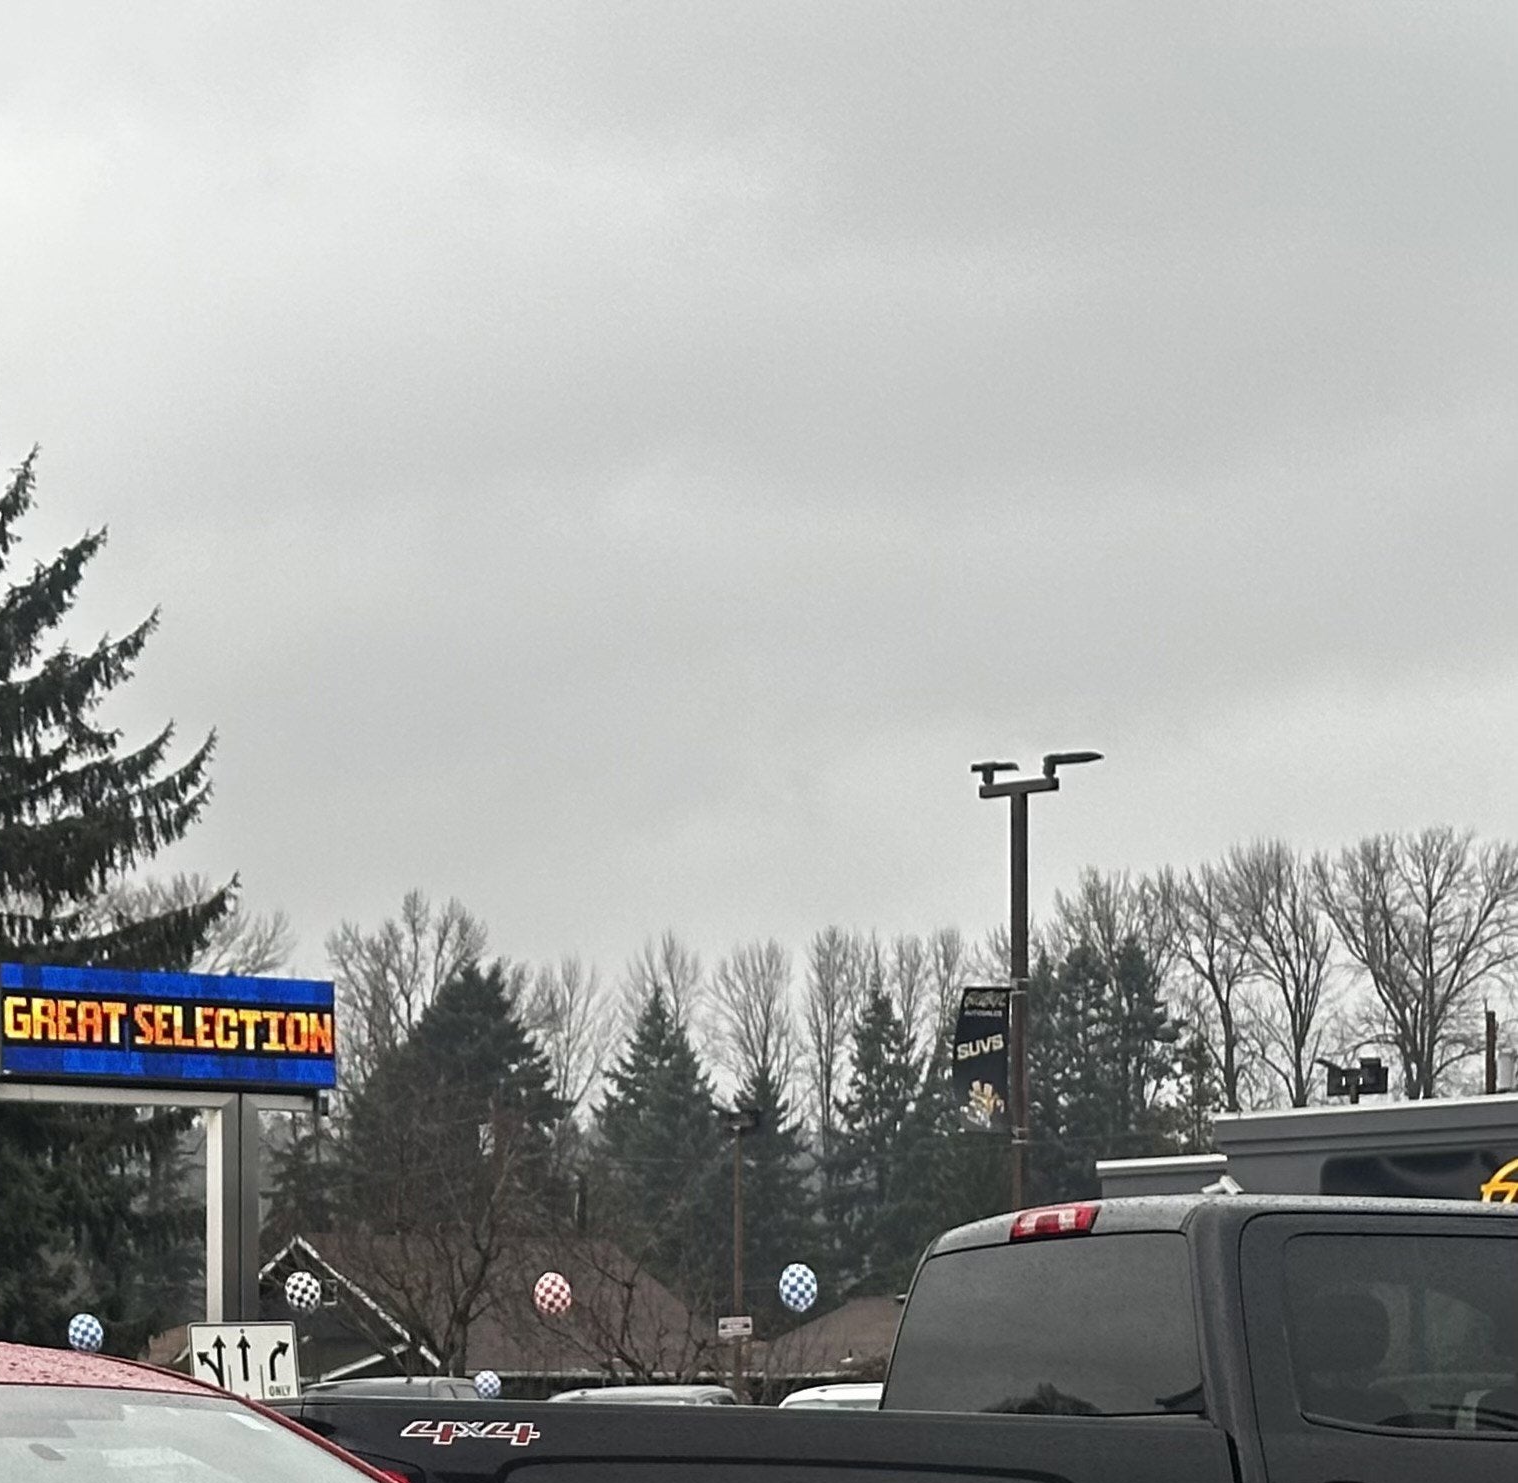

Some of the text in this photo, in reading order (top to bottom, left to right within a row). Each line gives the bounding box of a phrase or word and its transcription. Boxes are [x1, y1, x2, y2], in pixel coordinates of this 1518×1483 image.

[3, 996, 334, 1055] GREAT SELECTION
[268, 1384, 291, 1397] ONLY
